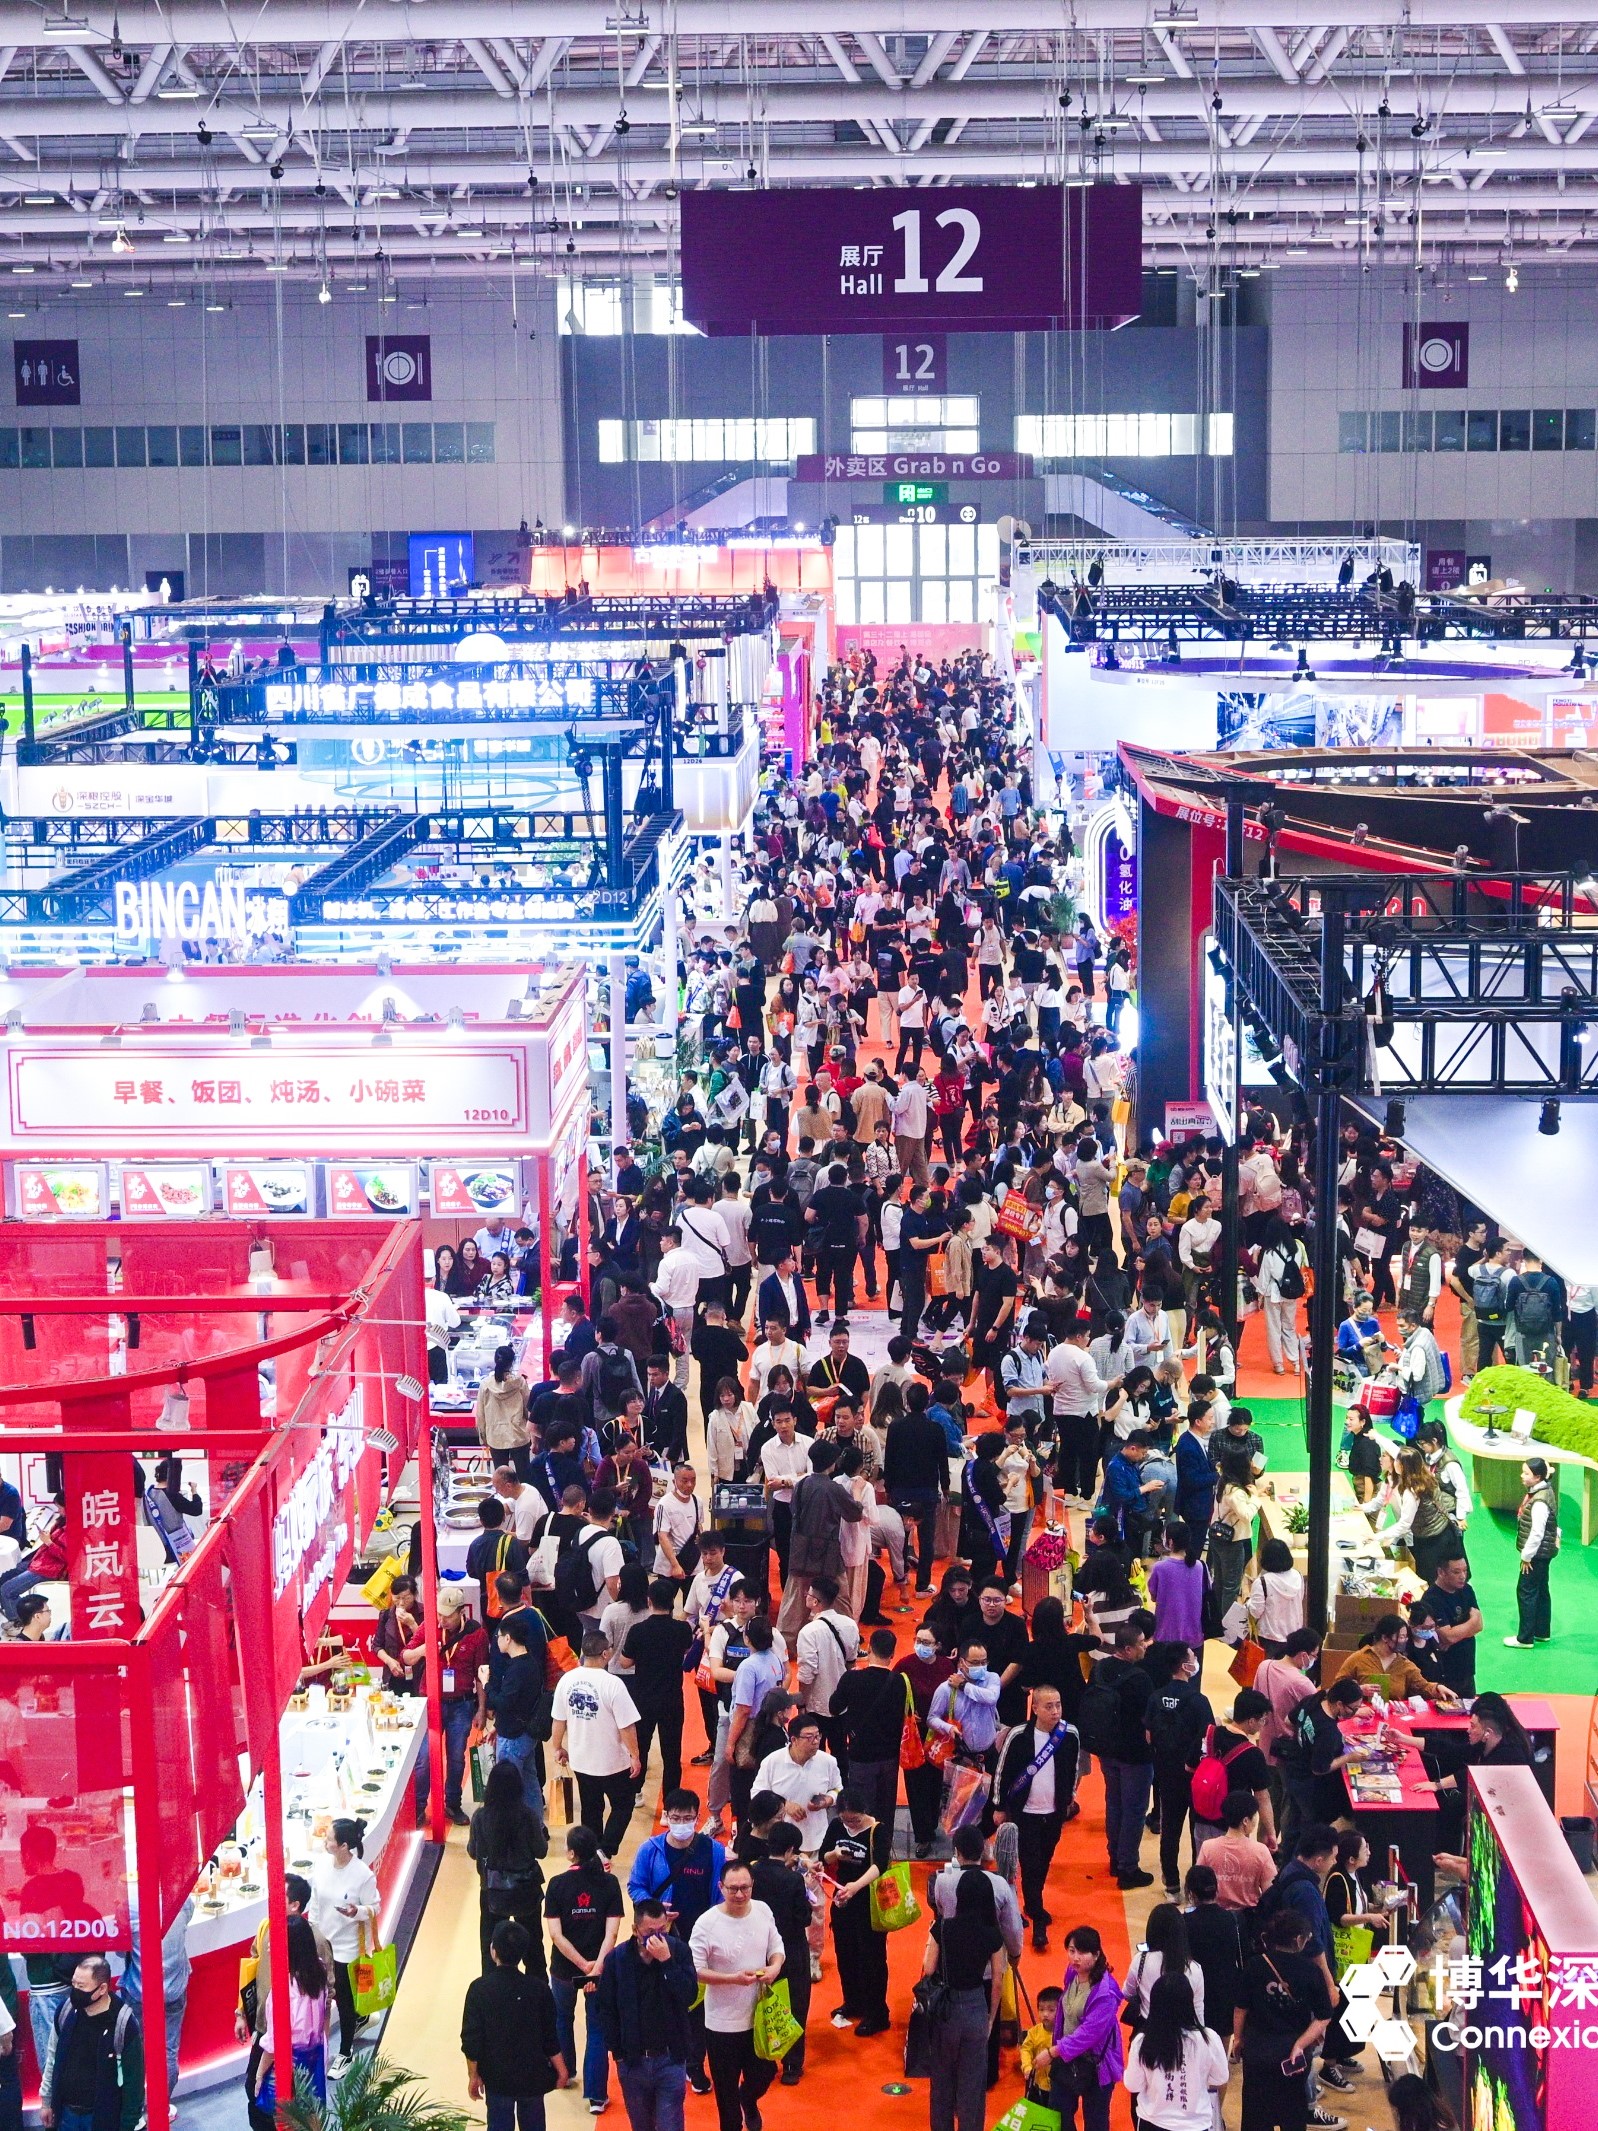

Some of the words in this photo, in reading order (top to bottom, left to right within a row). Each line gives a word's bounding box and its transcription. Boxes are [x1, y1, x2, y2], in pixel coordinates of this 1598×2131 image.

[839, 245, 884, 267] 展厅
[892, 208, 984, 293] 12
[840, 274, 883, 295] Hall
[895, 344, 935, 380] 12
[824, 457, 888, 478] 外卖区
[893, 456, 946, 474] Grab
[952, 460, 964, 473] n
[971, 456, 1001, 474] Go
[916, 506, 936, 523] 10
[115, 881, 246, 940] BINCAN
[113, 1079, 426, 1105] 早餐、饭团、炖汤、小碗菜
[463, 1108, 509, 1122] 12D10
[80, 1488, 125, 1630] 皖岚云
